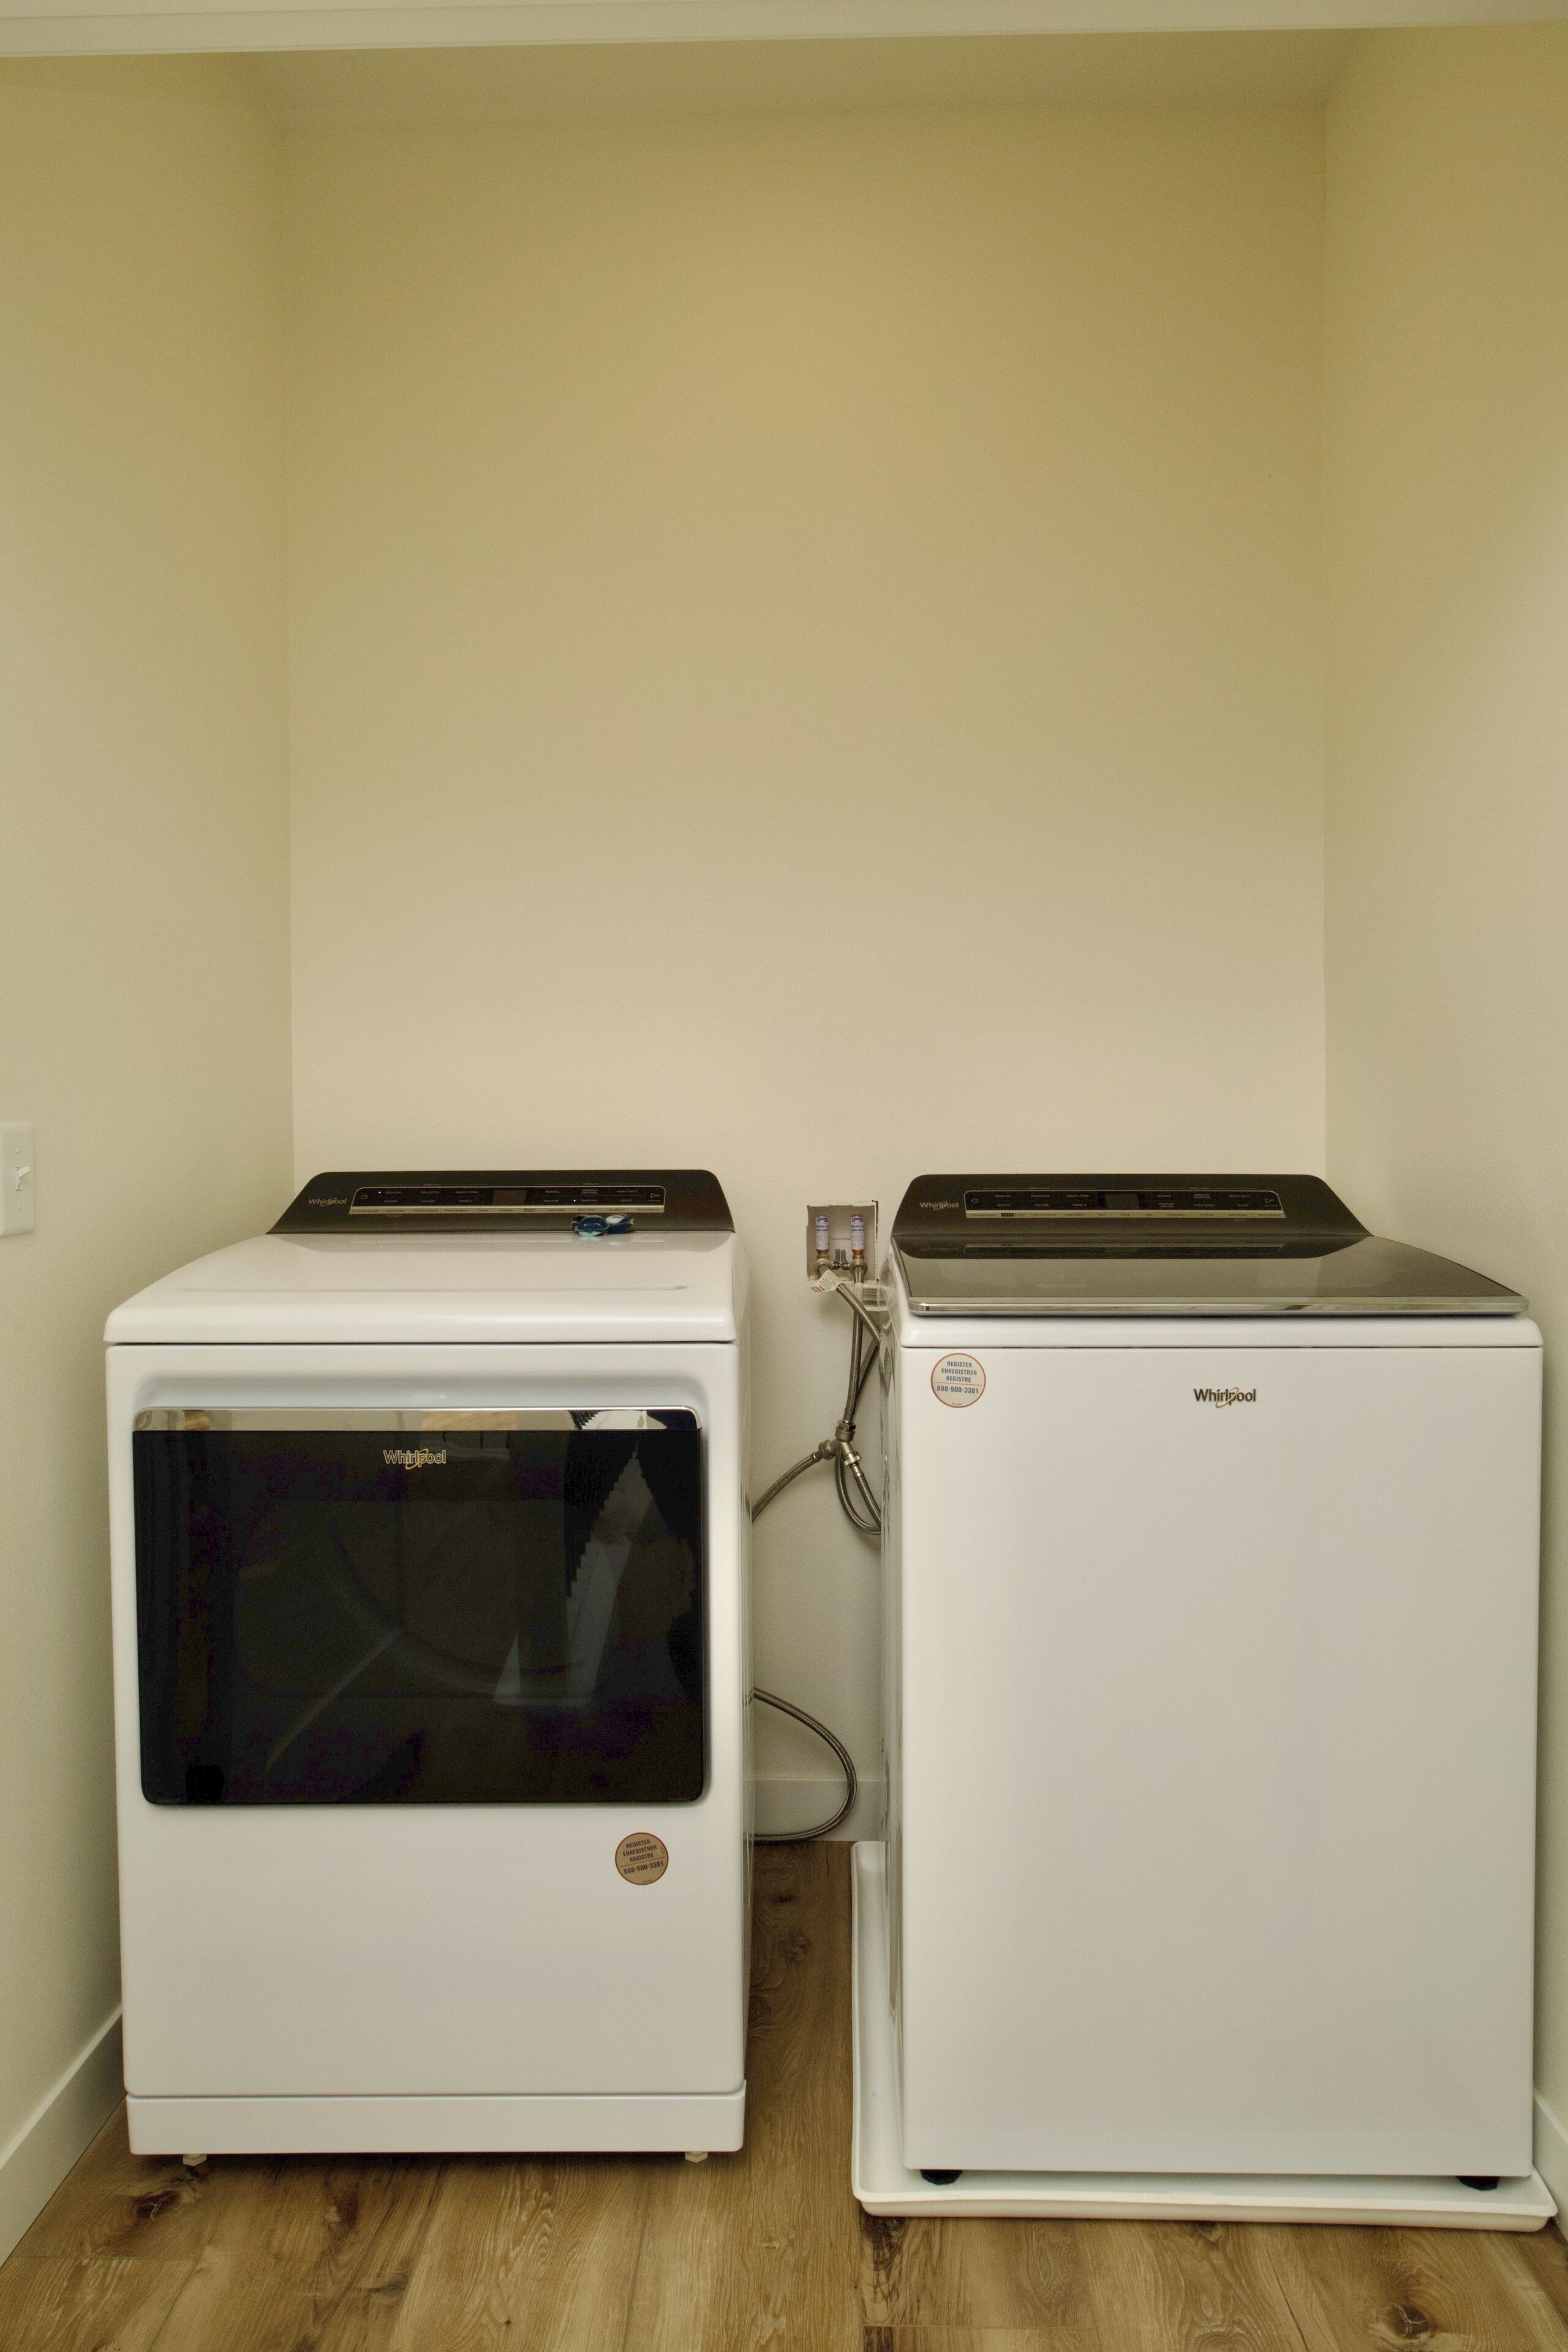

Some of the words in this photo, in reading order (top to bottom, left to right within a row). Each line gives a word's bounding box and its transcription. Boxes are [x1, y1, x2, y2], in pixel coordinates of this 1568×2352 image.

[309, 1198, 347, 1207] Whirlpool
[920, 1201, 959, 1210] Whirlpool
[937, 1385, 979, 1394] 888-900-3381
[1193, 1387, 1256, 1408] Whirlpool
[383, 1449, 447, 1469] Whirlpool
[626, 1839, 650, 1849] REGISTER
[623, 1844, 657, 1856] ENREGISTRER
[629, 1852, 654, 1863] REGISTRE
[624, 1860, 664, 1874] 888-900-3381
